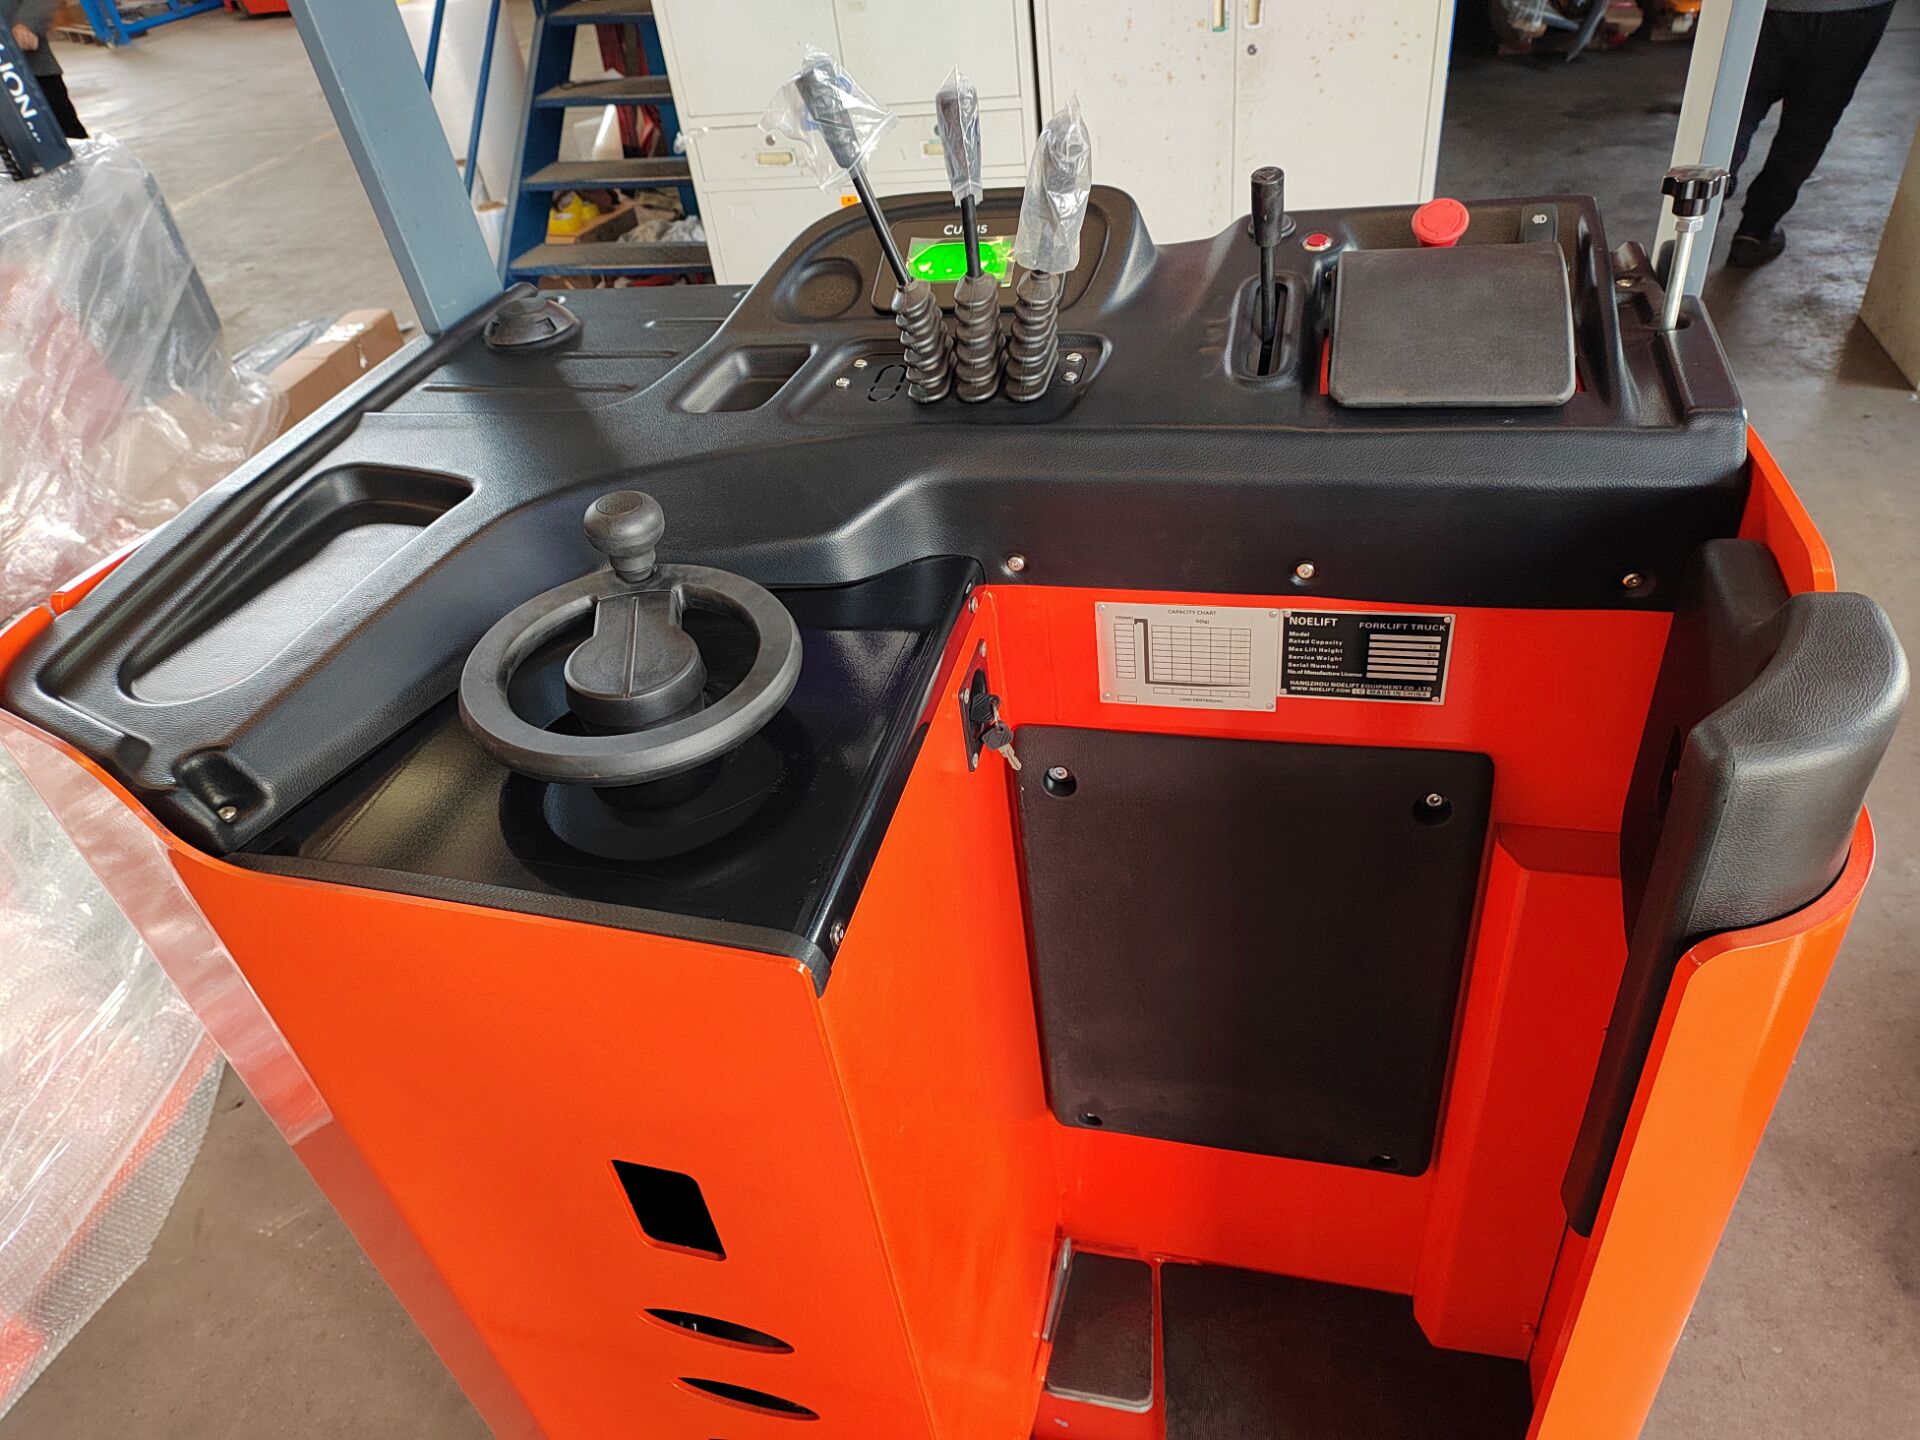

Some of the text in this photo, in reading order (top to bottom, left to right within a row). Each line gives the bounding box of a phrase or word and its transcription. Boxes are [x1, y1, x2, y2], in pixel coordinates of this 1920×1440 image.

[1289, 617, 1338, 627] NOELIFT
[1411, 623, 1446, 631] TRUCK
[1360, 683, 1402, 691] EQUIPMENT
